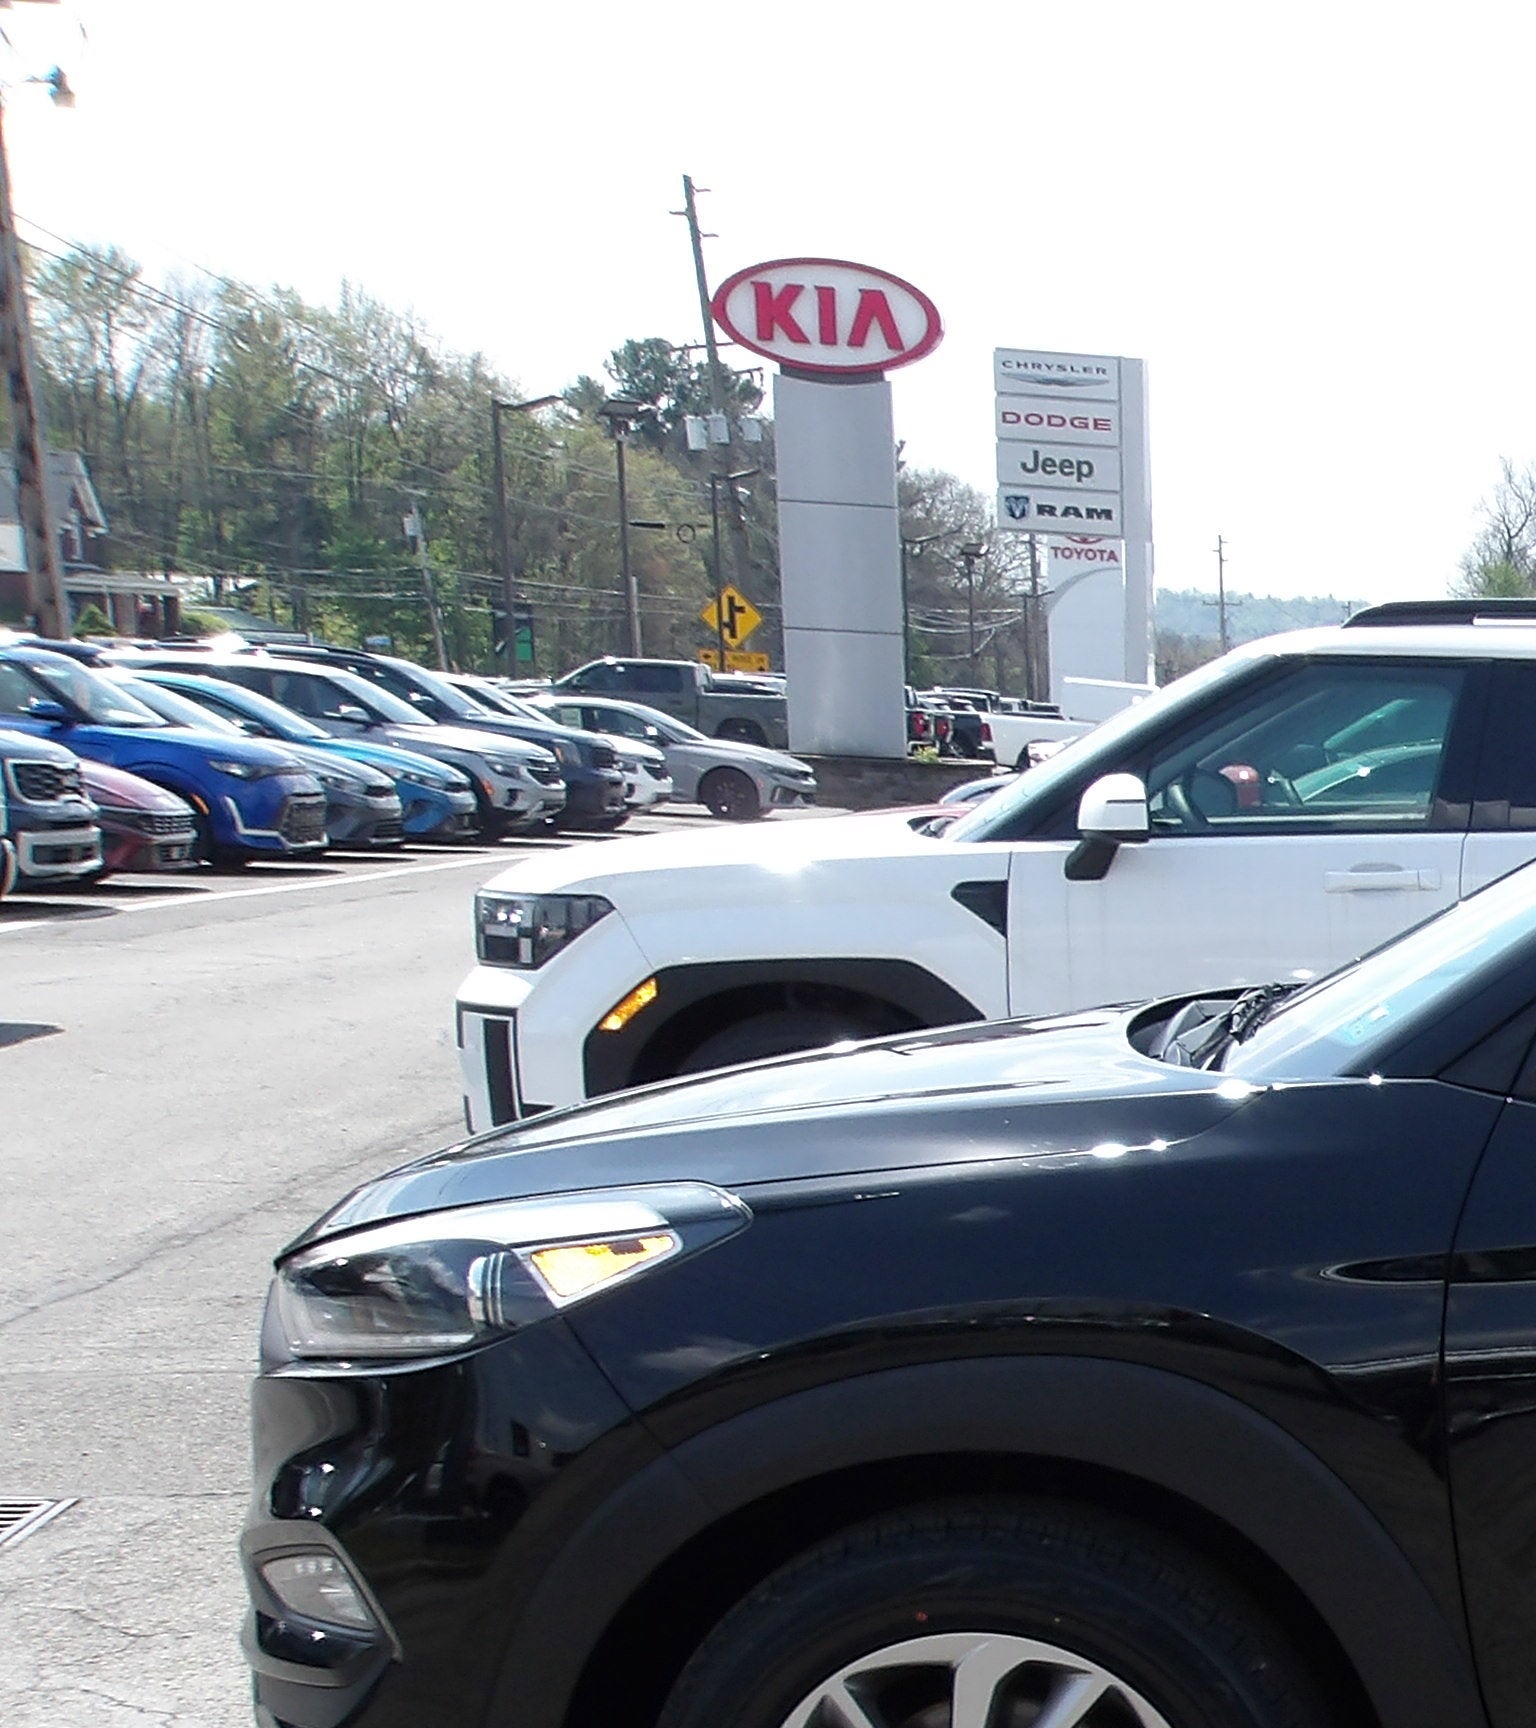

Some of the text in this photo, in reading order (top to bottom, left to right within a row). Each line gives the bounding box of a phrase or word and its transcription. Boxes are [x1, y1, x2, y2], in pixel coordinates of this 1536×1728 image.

[751, 281, 905, 351] KIA
[1002, 360, 1108, 375] CHRYSLER
[1002, 411, 1112, 431] DODGE
[1021, 449, 1094, 482] Jeep
[1036, 503, 1113, 520] RAM
[1050, 546, 1119, 562] TOYOTA
